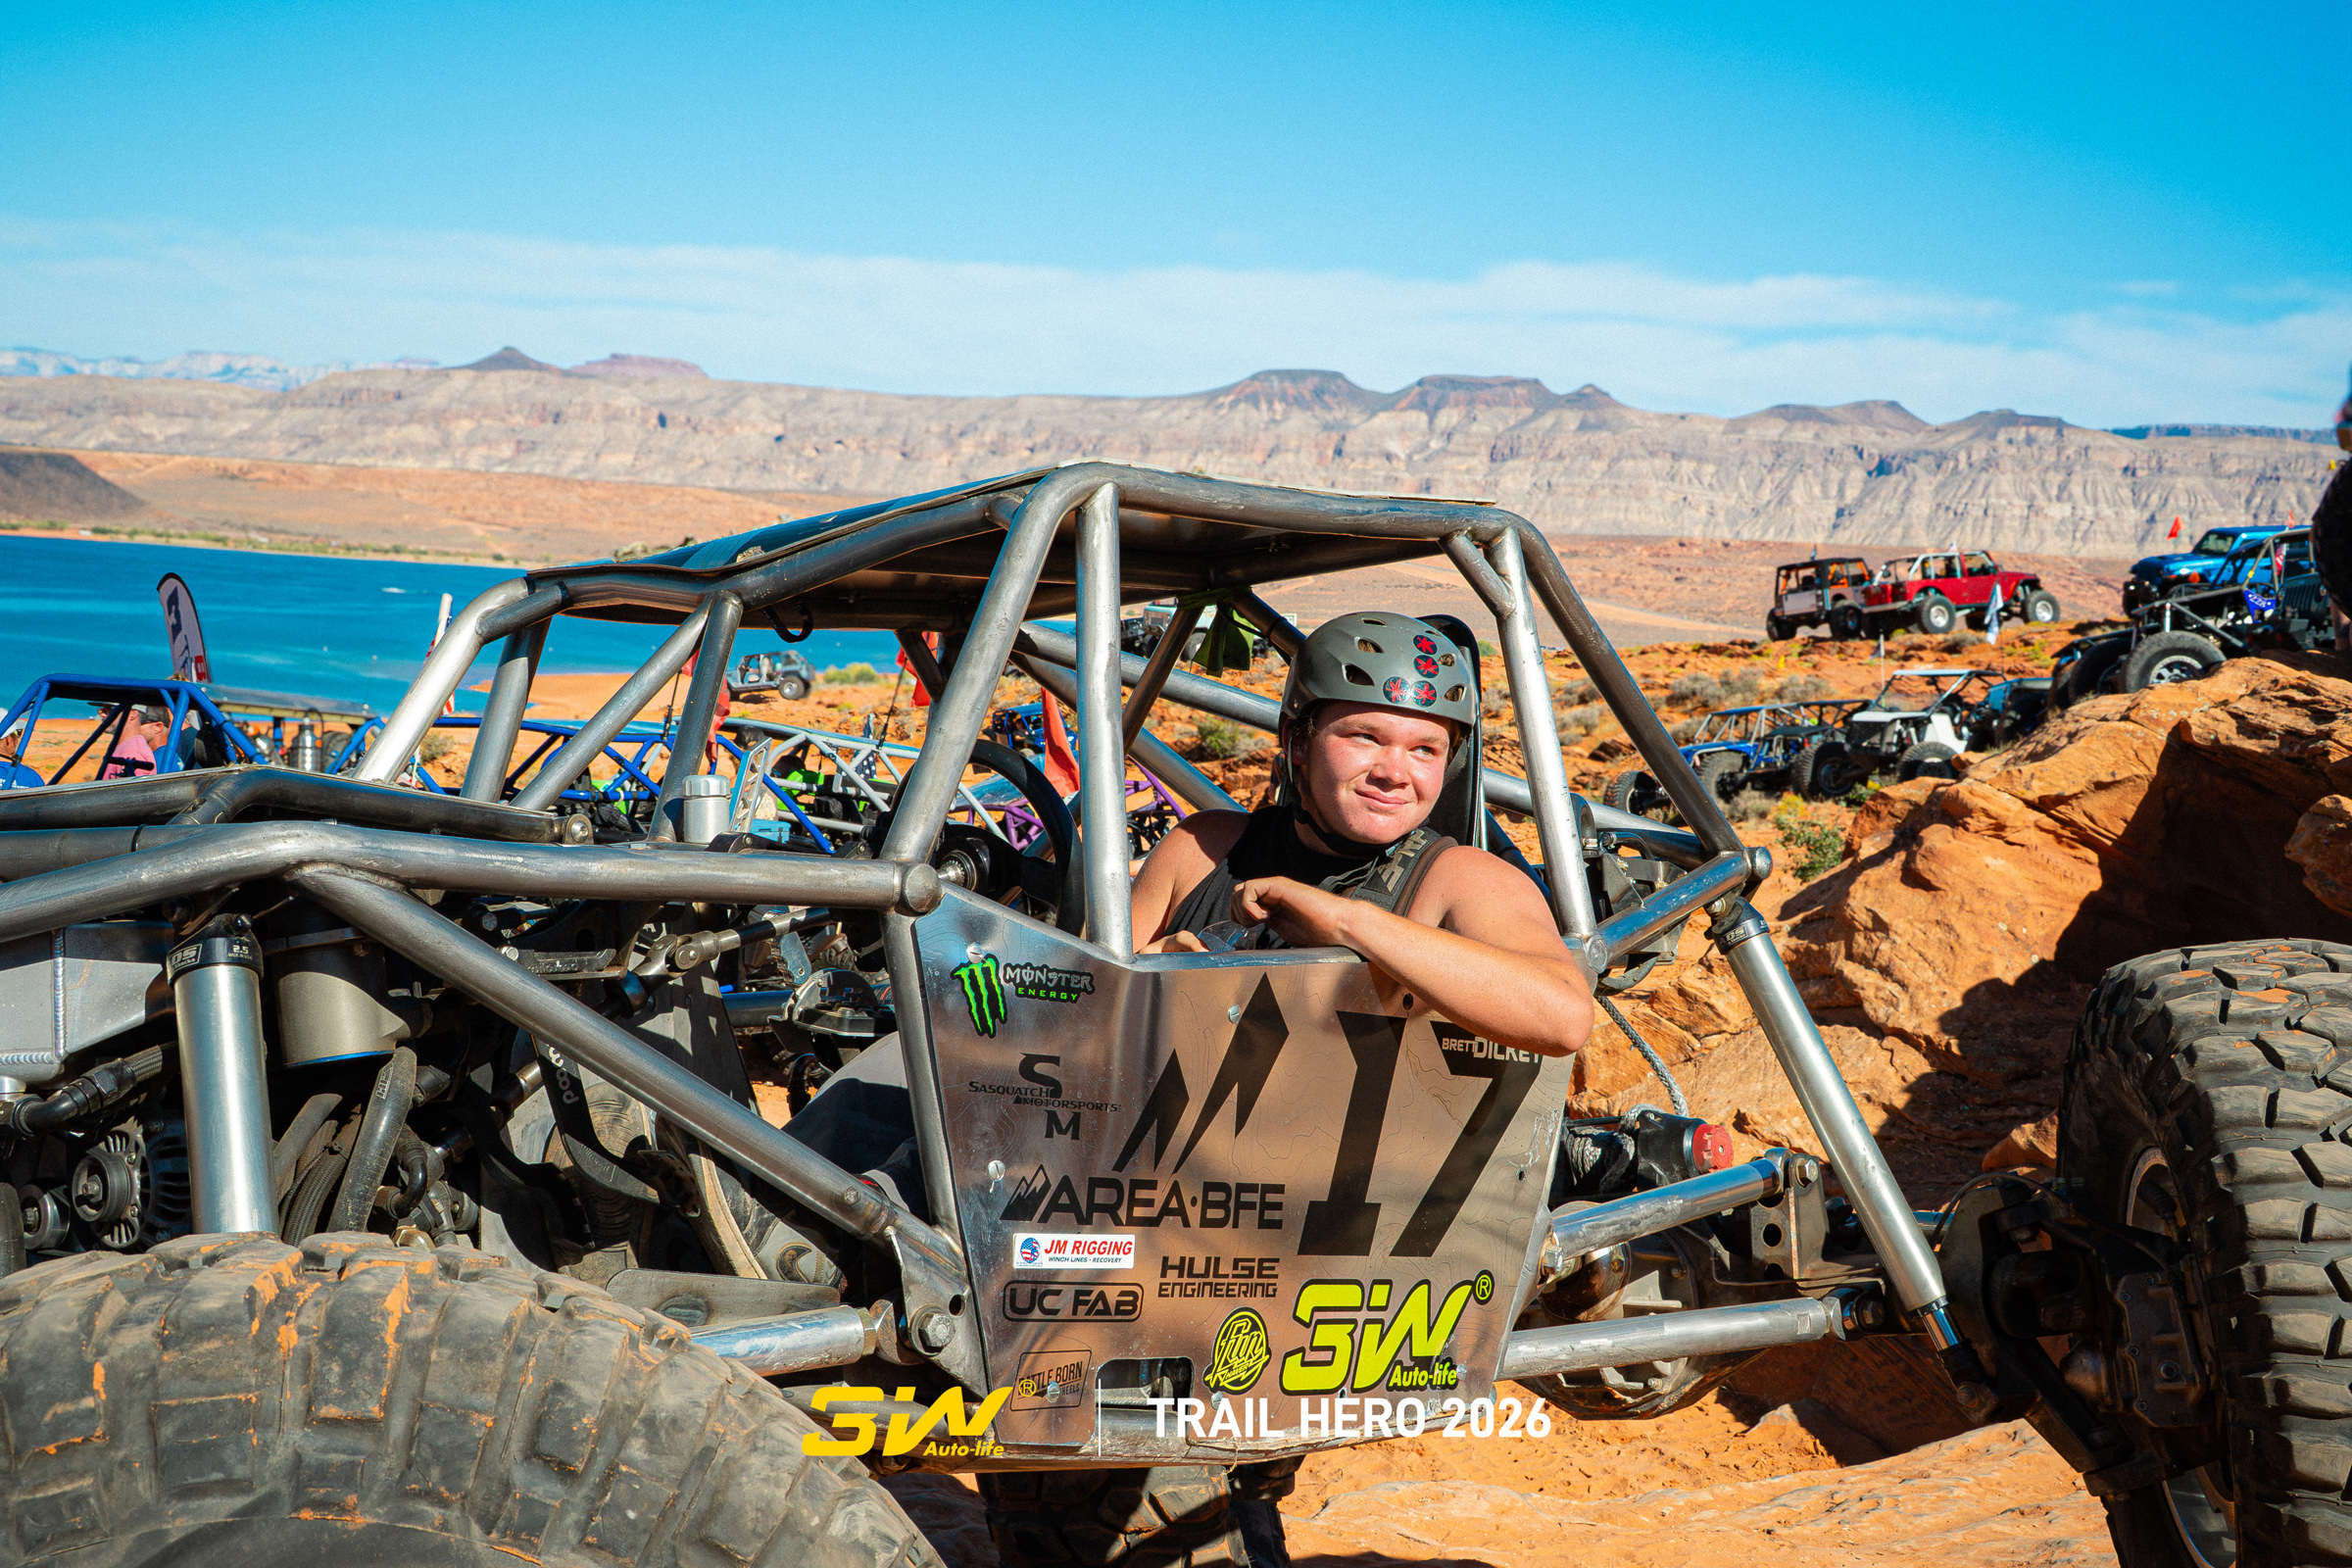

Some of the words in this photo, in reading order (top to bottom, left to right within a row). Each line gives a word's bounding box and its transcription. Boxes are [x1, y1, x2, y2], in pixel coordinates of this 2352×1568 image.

[232, 944, 249, 955] 2.5
[1005, 965, 1093, 992] MONSTER
[1018, 987, 1078, 1001] ENERGY
[1442, 1037, 1478, 1054] BRETT
[1017, 1052, 1063, 1099] S
[968, 1081, 1051, 1098] SASQUATCH
[1022, 1097, 1118, 1112] MOTORSPORTS
[1044, 1108, 1081, 1140] M
[1298, 1010, 1544, 1257] 17
[1044, 1240, 1068, 1254] JM
[1071, 1240, 1133, 1255] RIGGING
[1159, 1255, 1281, 1279] HULSE
[1157, 1282, 1278, 1298] ENGINEERING
[1008, 1289, 1061, 1315] UC
[1071, 1289, 1140, 1317] FAB
[1055, 1360, 1083, 1384] BORN
[1389, 1362, 1457, 1387] Auto-life
[1058, 1383, 1080, 1396] HEELS
